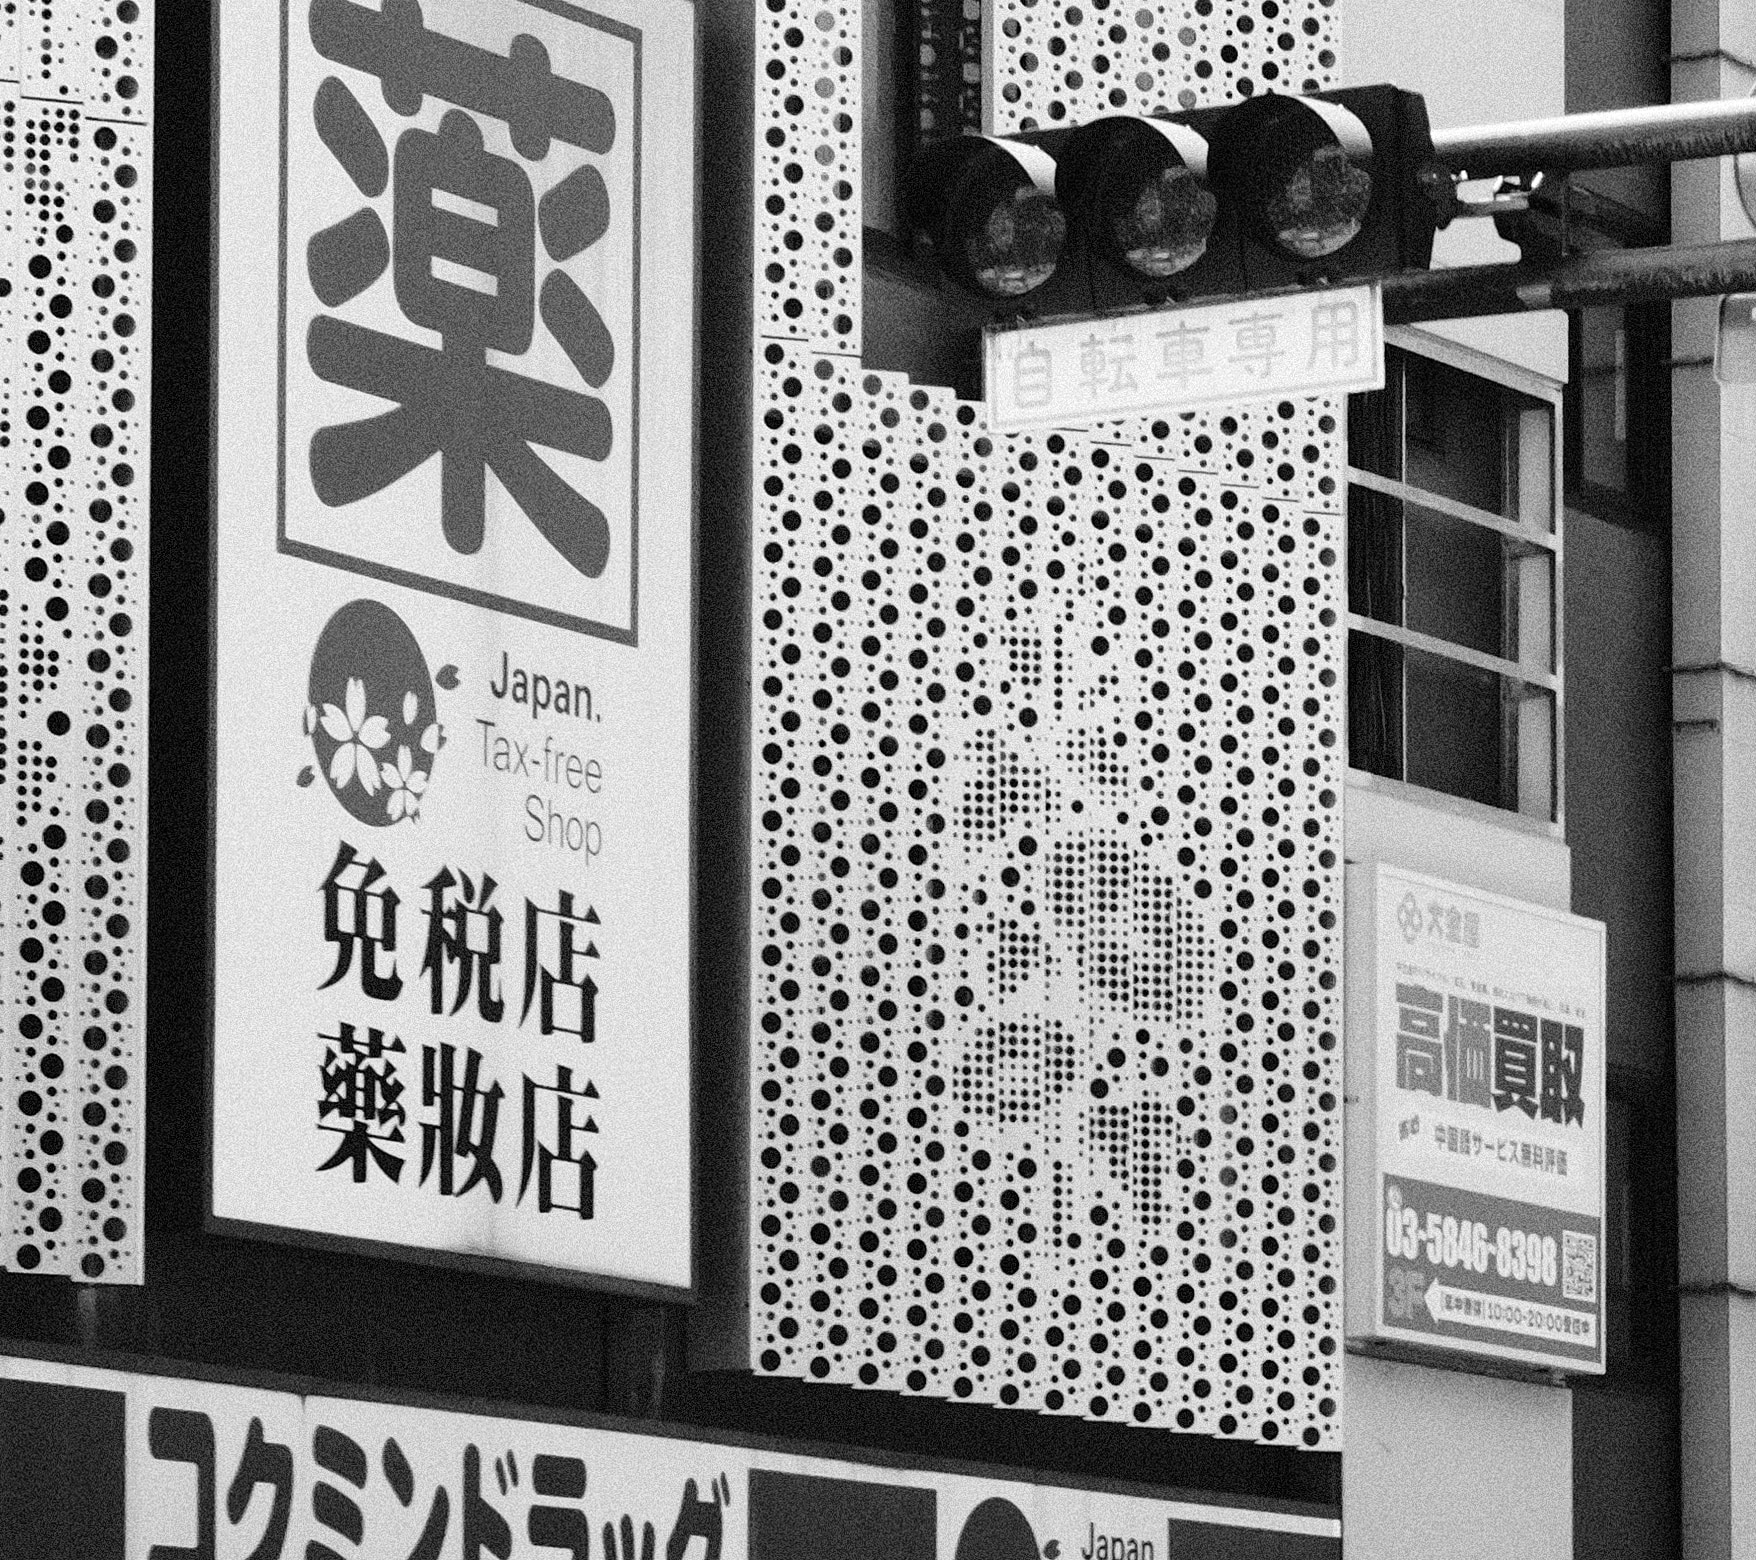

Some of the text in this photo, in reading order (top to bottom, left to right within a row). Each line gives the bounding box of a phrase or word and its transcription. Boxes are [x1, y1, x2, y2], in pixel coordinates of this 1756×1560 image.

[1011, 298, 1362, 409] 自転車専用
[489, 648, 605, 724] Japan.
[474, 717, 605, 794] Tax-free
[523, 792, 605, 864] Shop
[317, 841, 604, 1047] 免税店
[1395, 981, 1587, 1129] 高価買取
[1385, 1206, 1558, 1287] 03-5846-8398
[1387, 1267, 1426, 1321] 3F
